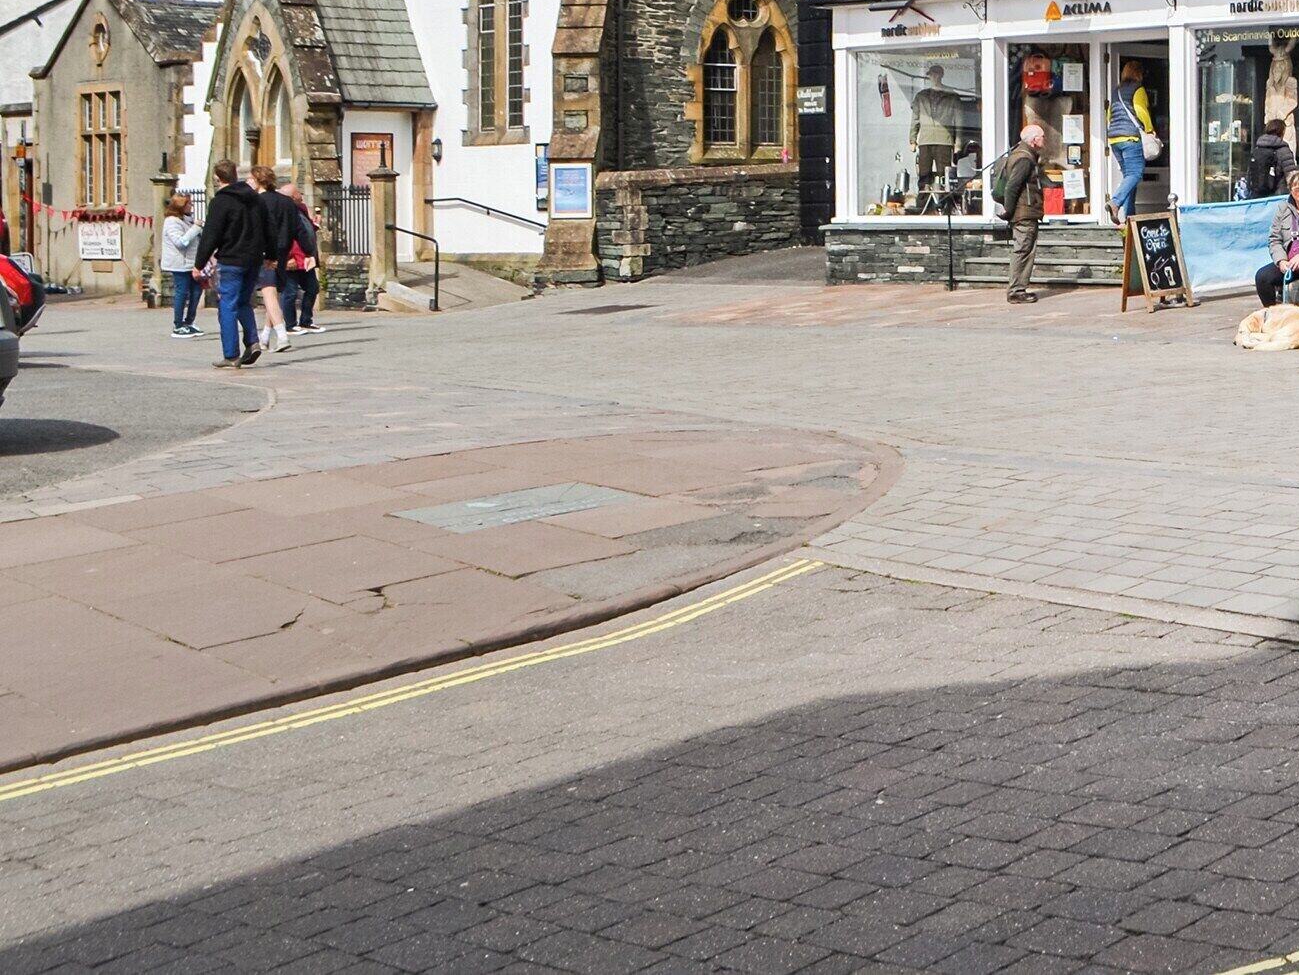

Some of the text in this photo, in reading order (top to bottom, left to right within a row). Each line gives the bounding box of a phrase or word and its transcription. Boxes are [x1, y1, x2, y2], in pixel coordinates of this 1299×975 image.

[1063, 1, 1112, 16] ACLIMA
[1207, 33, 1221, 42] The
[1222, 30, 1276, 42] Scandinavian
